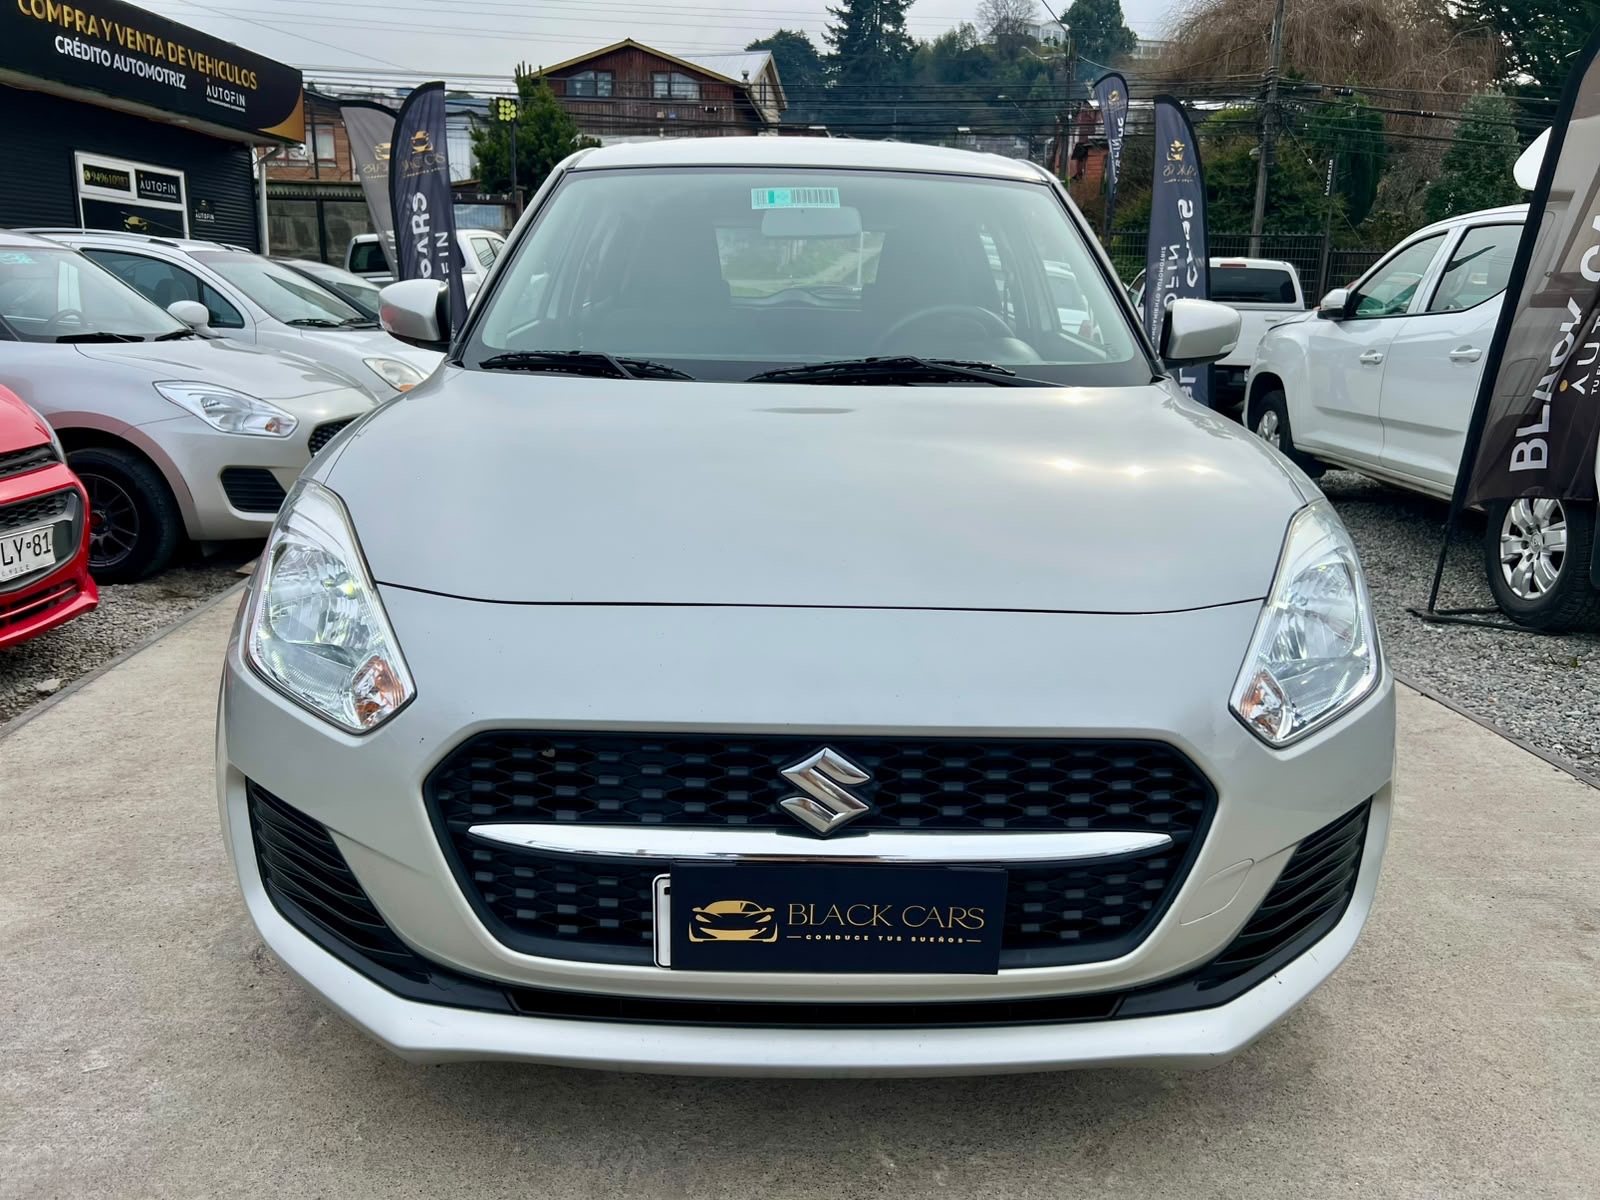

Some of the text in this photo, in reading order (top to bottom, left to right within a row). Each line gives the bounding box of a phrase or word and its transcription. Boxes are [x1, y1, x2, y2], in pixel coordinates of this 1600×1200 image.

[18, 0, 258, 90] COMPRA Y VENTA DE VEHICULOS
[55, 35, 187, 89] CRÉDITO AUTOMOTRIZ
[206, 83, 246, 107] AUTOFIN
[139, 179, 177, 195] AUTOFIN
[787, 903, 985, 930] BLACK CARS
[911, 935, 964, 944] SUEÑOS
